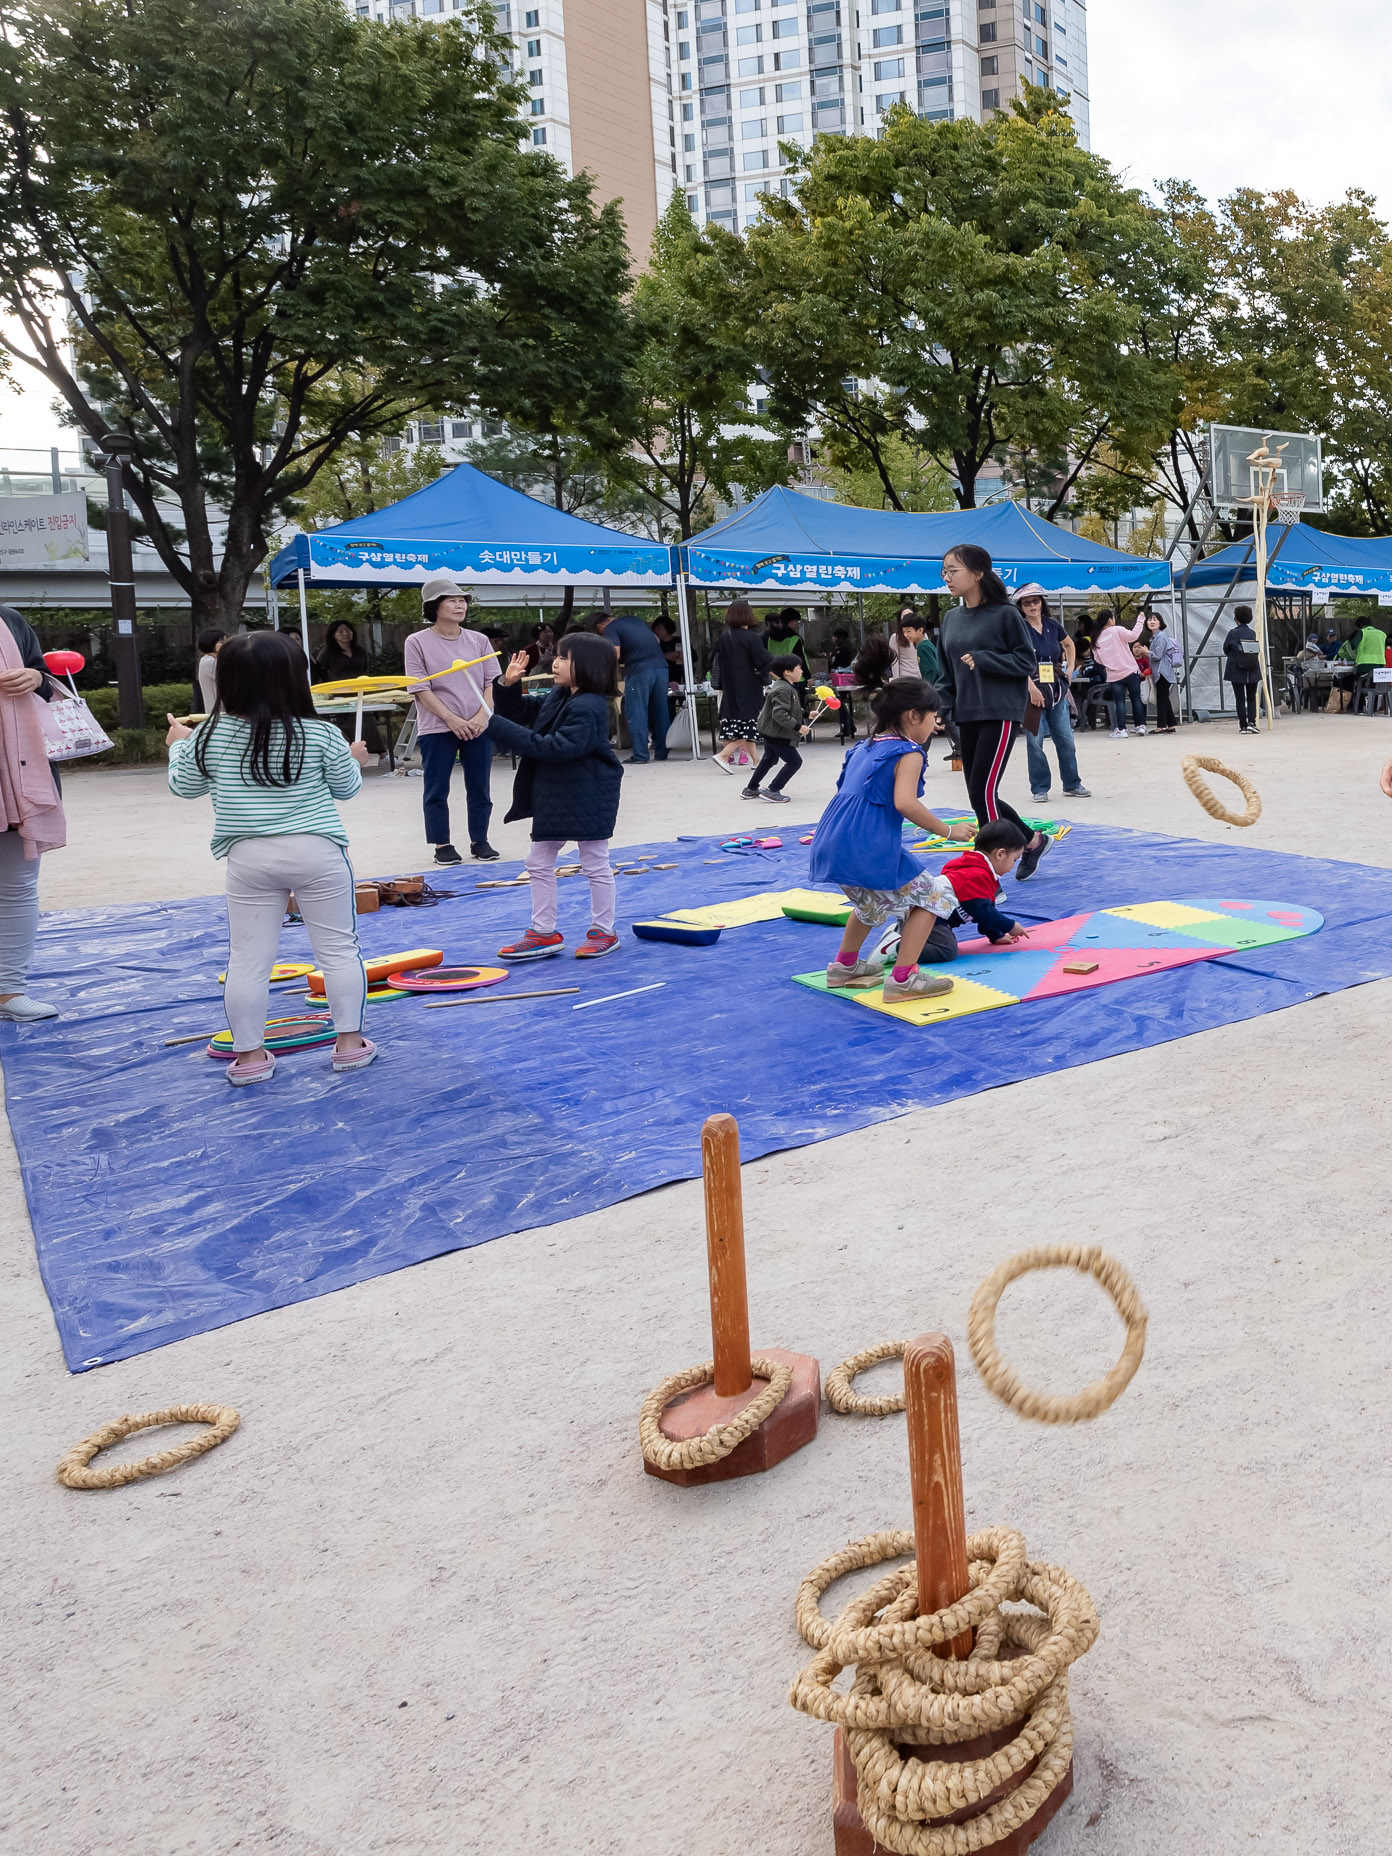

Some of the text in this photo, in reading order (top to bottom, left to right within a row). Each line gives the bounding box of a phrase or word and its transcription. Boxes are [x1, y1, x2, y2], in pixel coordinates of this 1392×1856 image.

[48, 513, 77, 531] 진입금지
[358, 551, 429, 563] 구삼열린축제
[478, 549, 558, 565] 솟대만들기
[771, 563, 860, 580] 구삼열린축제
[1312, 571, 1364, 584] 구삼열린축제
[920, 1008, 950, 1017] 2
